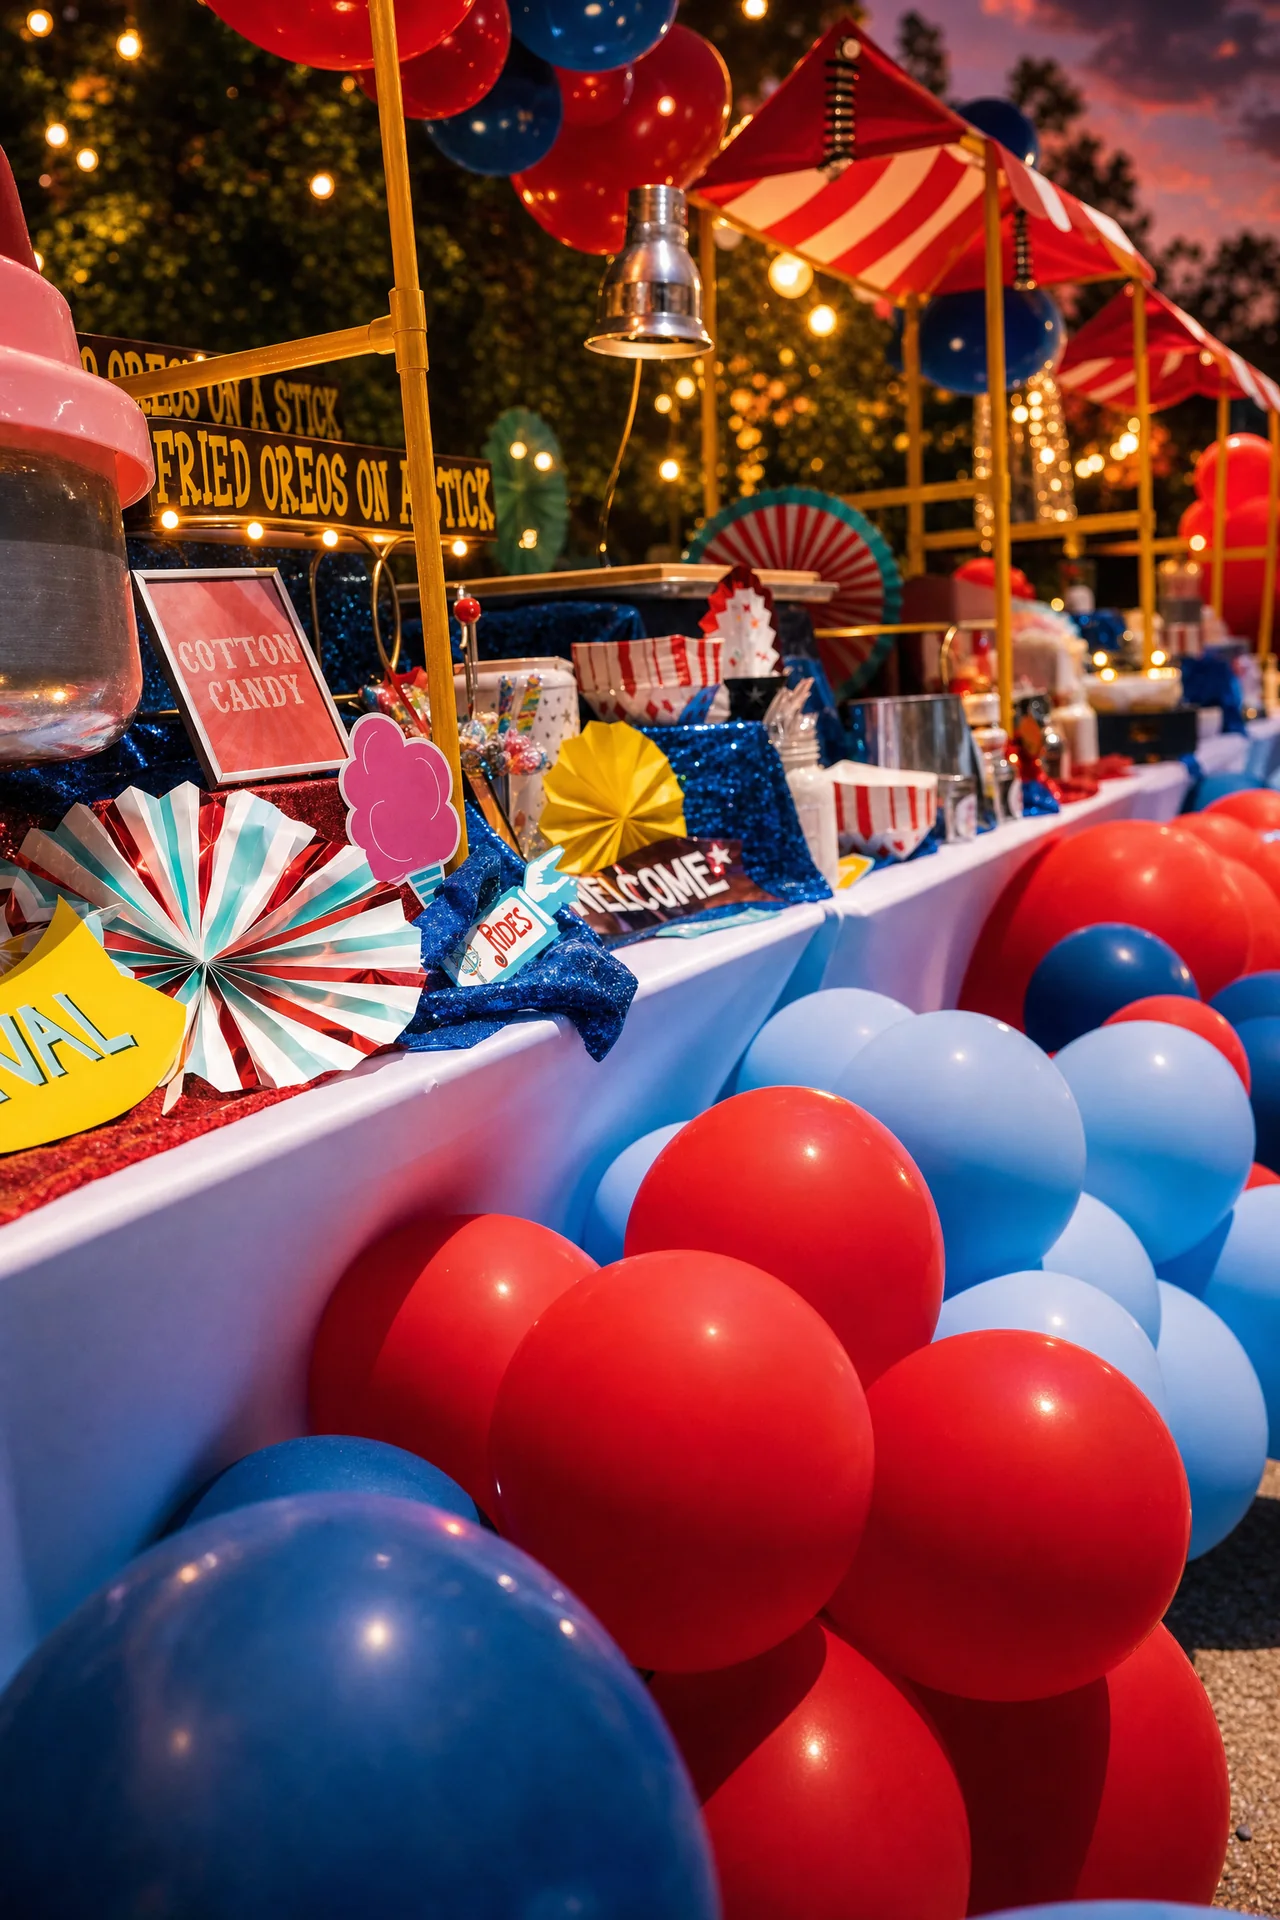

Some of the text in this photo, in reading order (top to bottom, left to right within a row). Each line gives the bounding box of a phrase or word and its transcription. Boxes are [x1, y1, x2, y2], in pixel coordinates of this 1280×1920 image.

[207, 380, 242, 427] ON
[250, 376, 270, 431] A
[274, 378, 343, 440] STICK
[152, 429, 250, 509] FRIED
[260, 444, 349, 517] OREOS
[356, 458, 390, 522] ON
[436, 465, 496, 531] TICK
[178, 633, 301, 674] COTTON
[208, 673, 305, 714] CANDY
[477, 907, 533, 968] RIDES
[0, 991, 139, 1104] VAL
